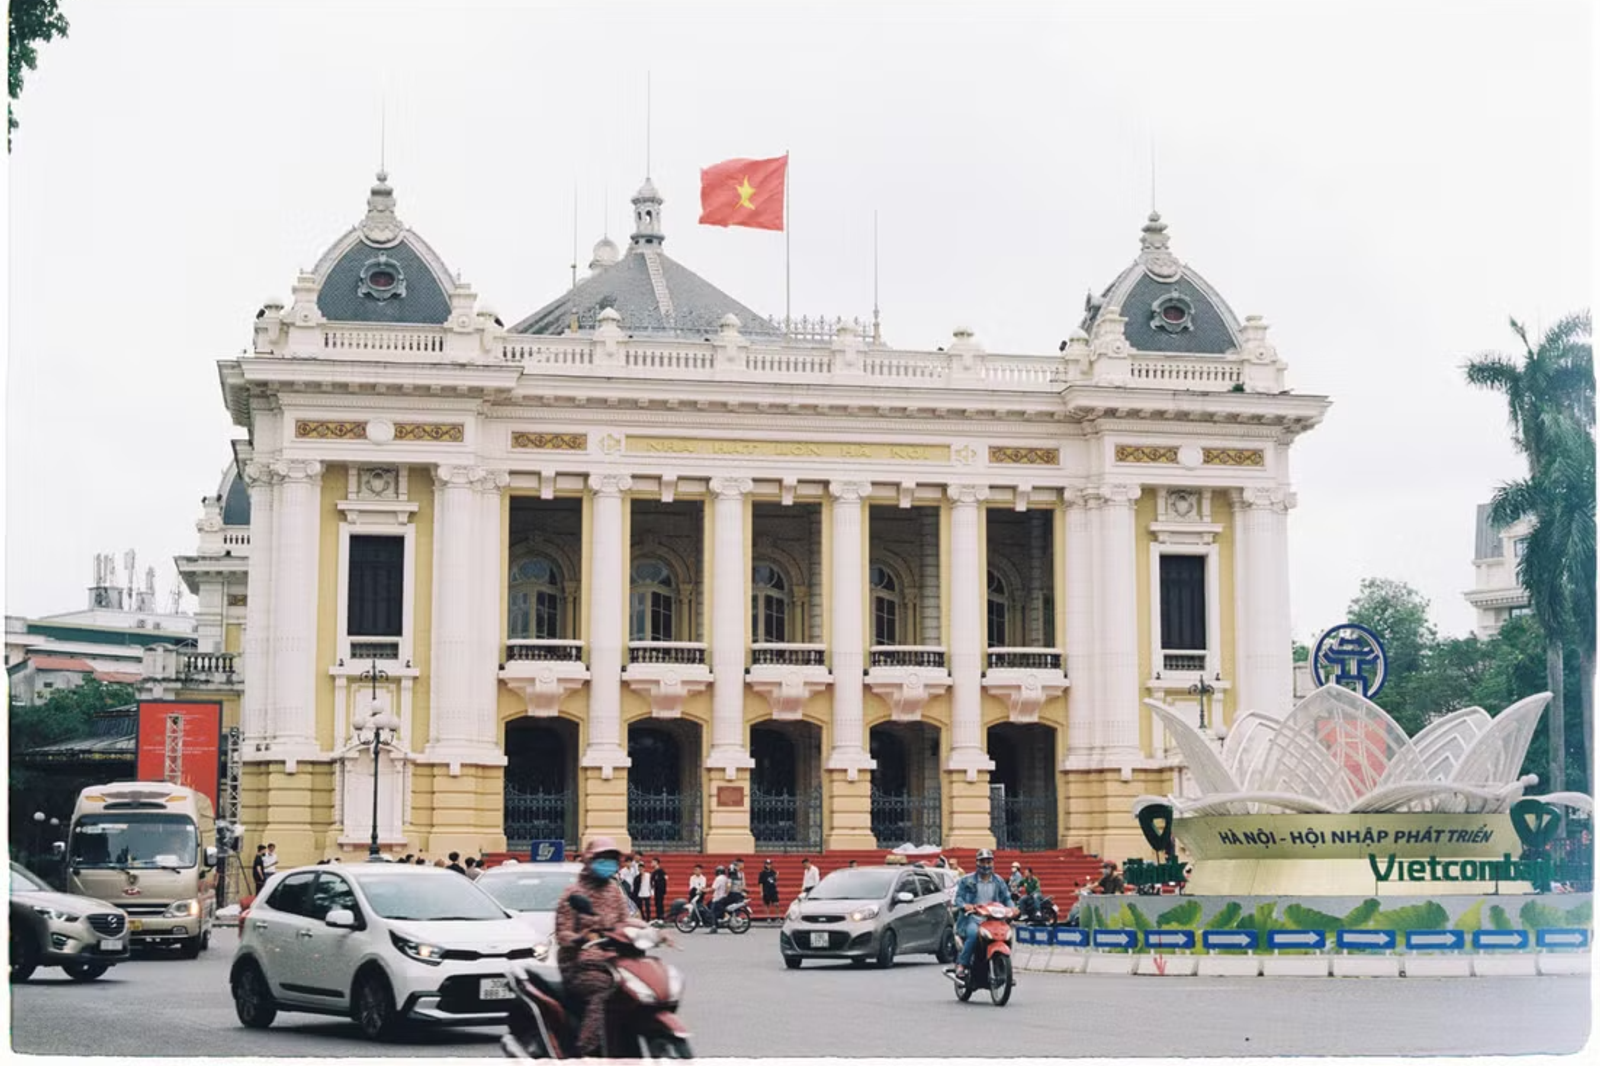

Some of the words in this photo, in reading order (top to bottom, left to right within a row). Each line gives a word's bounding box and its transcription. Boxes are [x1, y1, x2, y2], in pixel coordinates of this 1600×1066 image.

[1218, 828, 1243, 845] HÀ
[1243, 828, 1277, 849] NỘI
[1289, 827, 1326, 849] HỘI
[1330, 826, 1389, 847] NHẬP
[1393, 825, 1445, 844] PHÁT
[1447, 823, 1494, 844] TRIỂN
